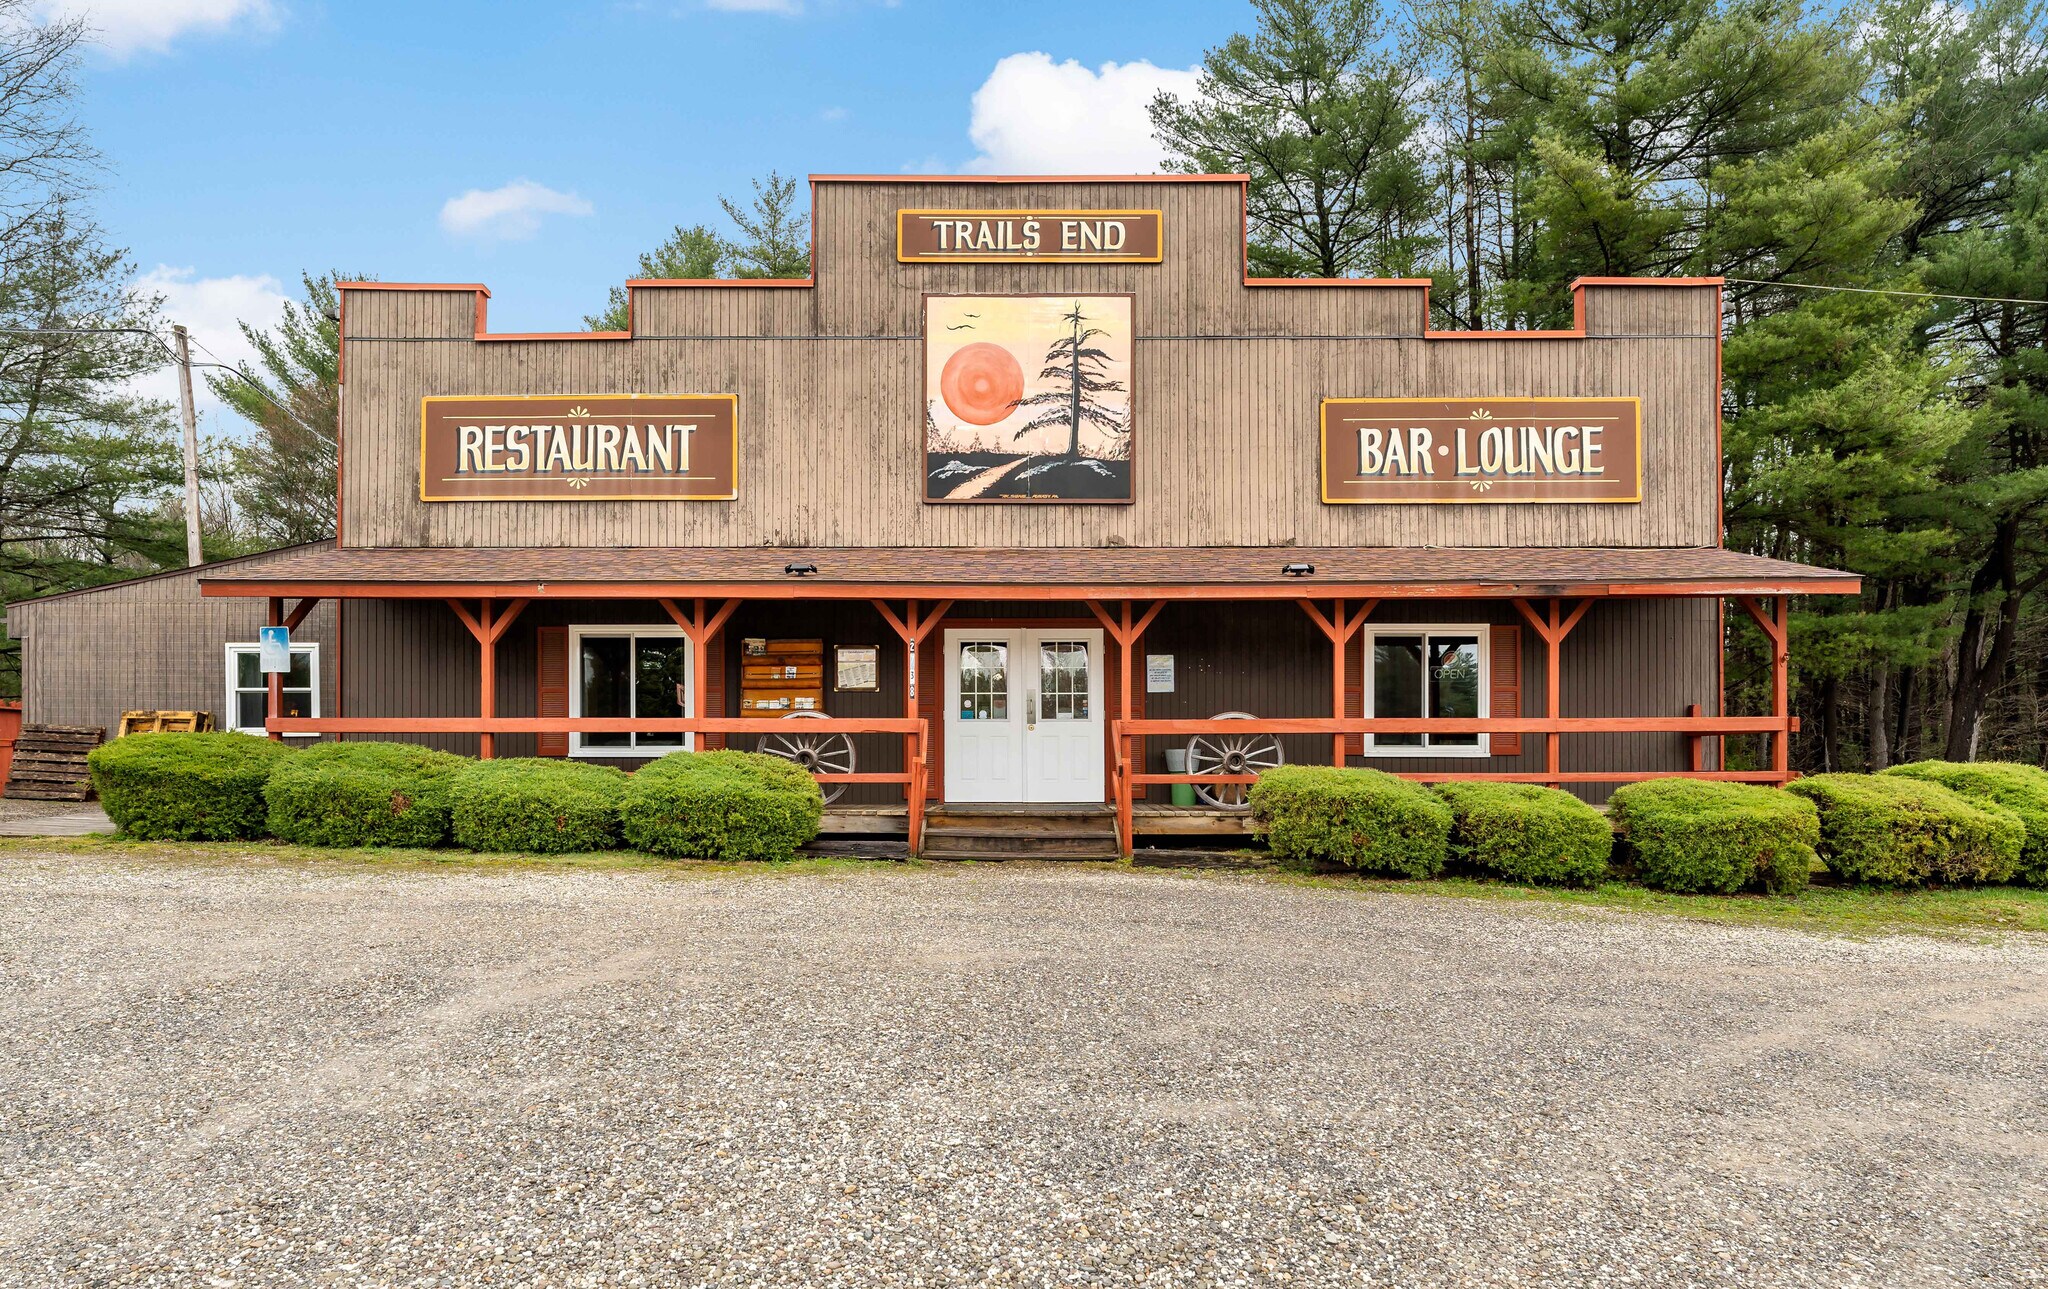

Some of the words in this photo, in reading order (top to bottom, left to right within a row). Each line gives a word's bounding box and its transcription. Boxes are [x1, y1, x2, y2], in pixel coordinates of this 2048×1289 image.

[932, 220, 1041, 250] TRAILS
[1060, 220, 1126, 250] END
[457, 423, 698, 473] RESTAURANT
[1357, 426, 1435, 475] BAR
[1455, 425, 1605, 475] LOUNGE
[1434, 668, 1466, 679] OPEN
